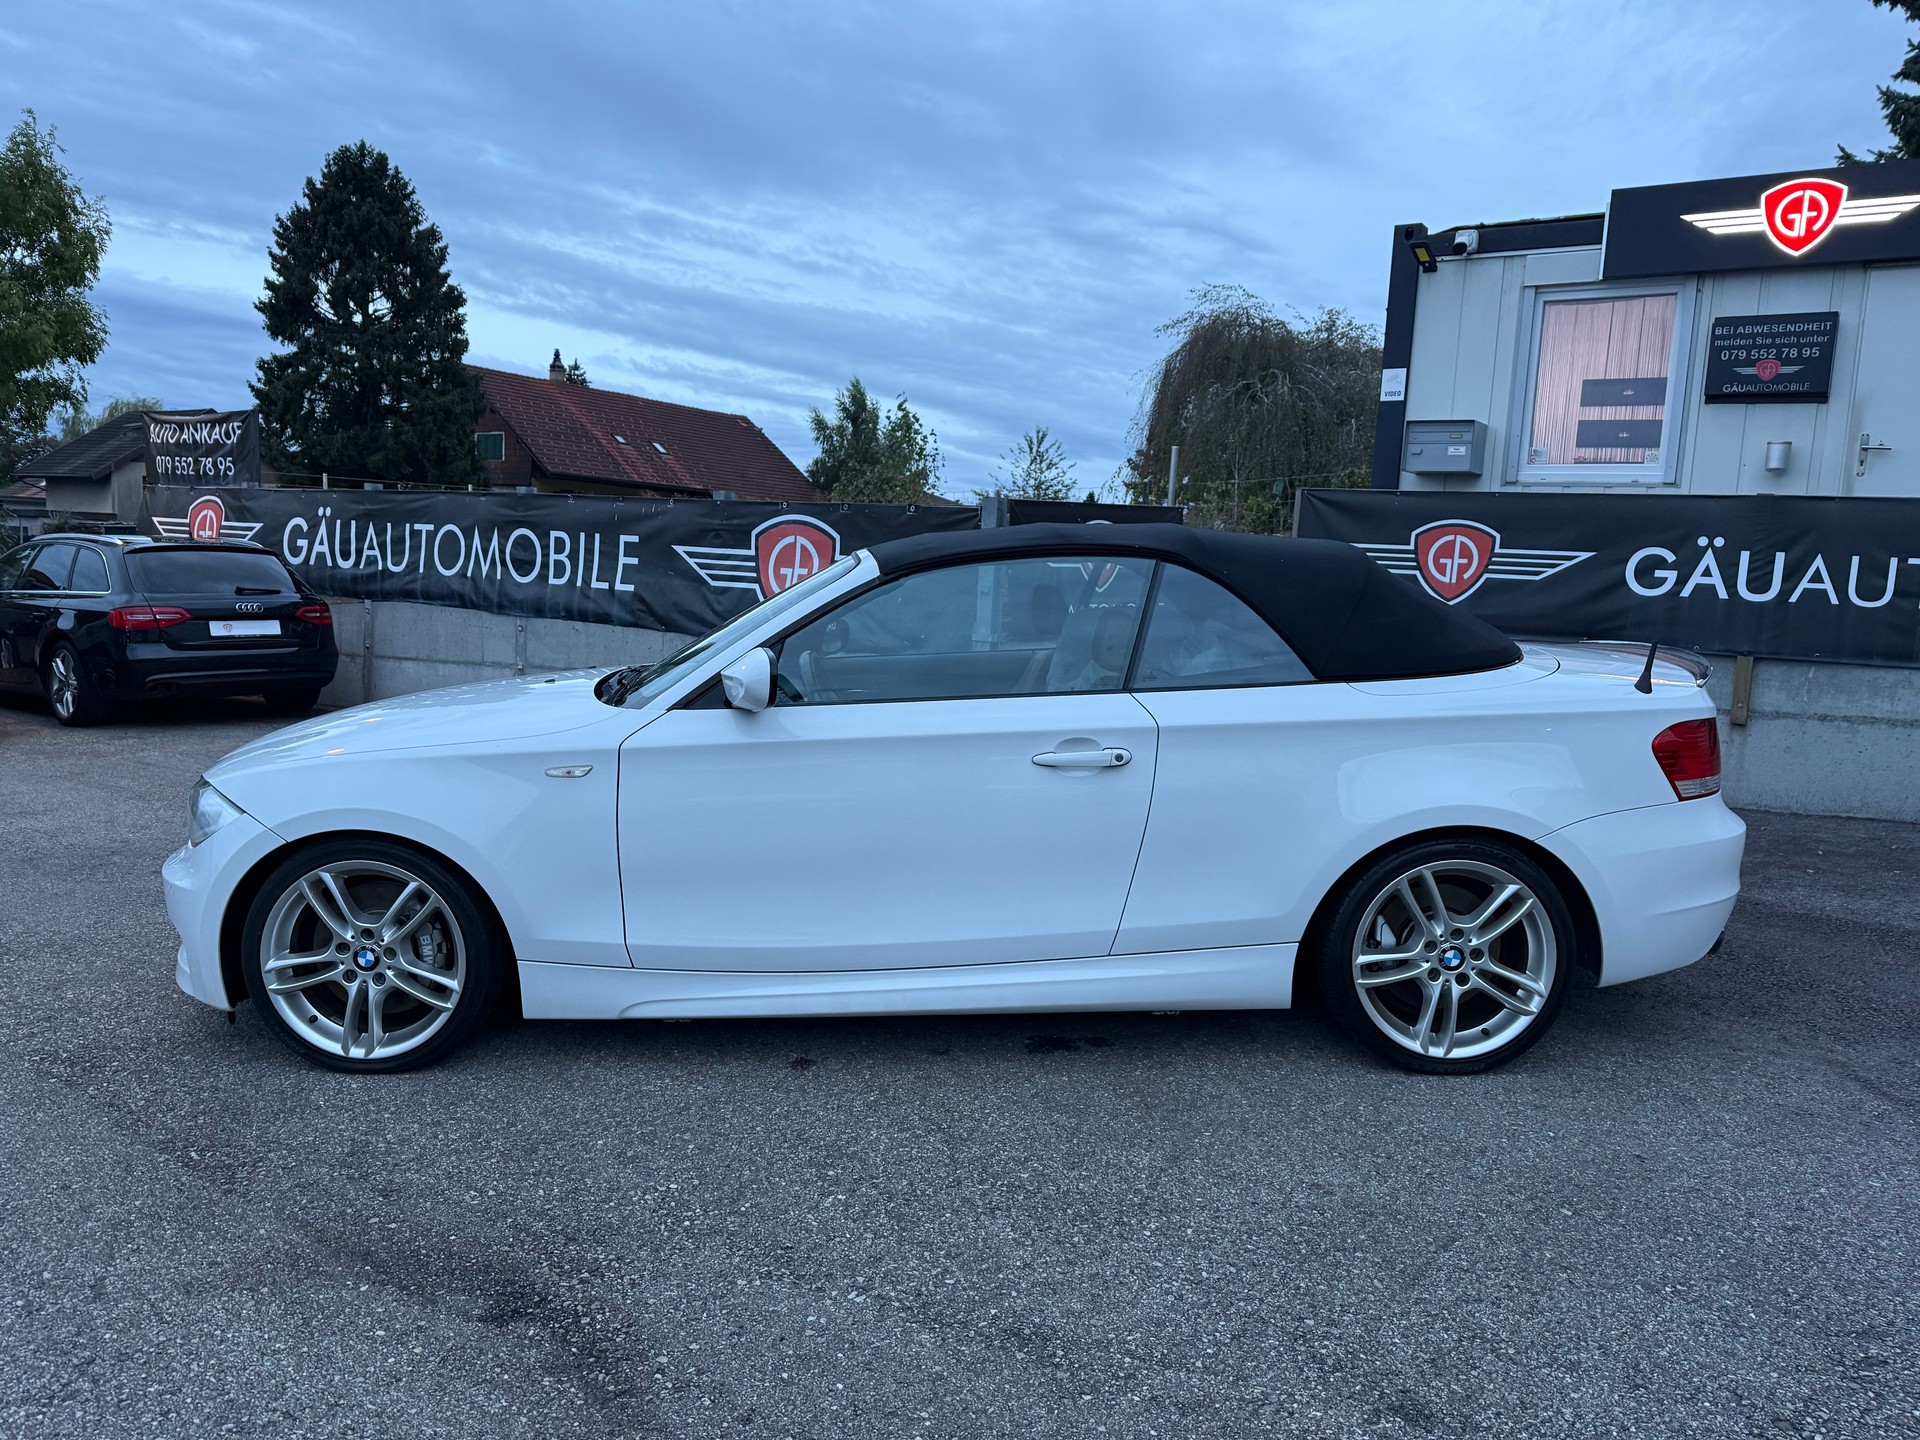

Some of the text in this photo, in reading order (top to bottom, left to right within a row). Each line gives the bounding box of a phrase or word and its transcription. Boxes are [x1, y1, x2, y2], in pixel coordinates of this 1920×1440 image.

[1774, 189, 1829, 237] GA
[1714, 321, 1833, 335] BEI ABWESENDHEIT
[1714, 334, 1830, 346] melden Sie sich unter
[1721, 347, 1820, 360] 079 552 78 95
[1722, 382, 1810, 392] GÄUAUTOMOBILE
[150, 422, 243, 444] AUTO ANKAUF
[156, 455, 235, 476] 079 552 78 95
[282, 505, 640, 592] GÄUAUTOMOBILE
[1427, 534, 1479, 583] GA
